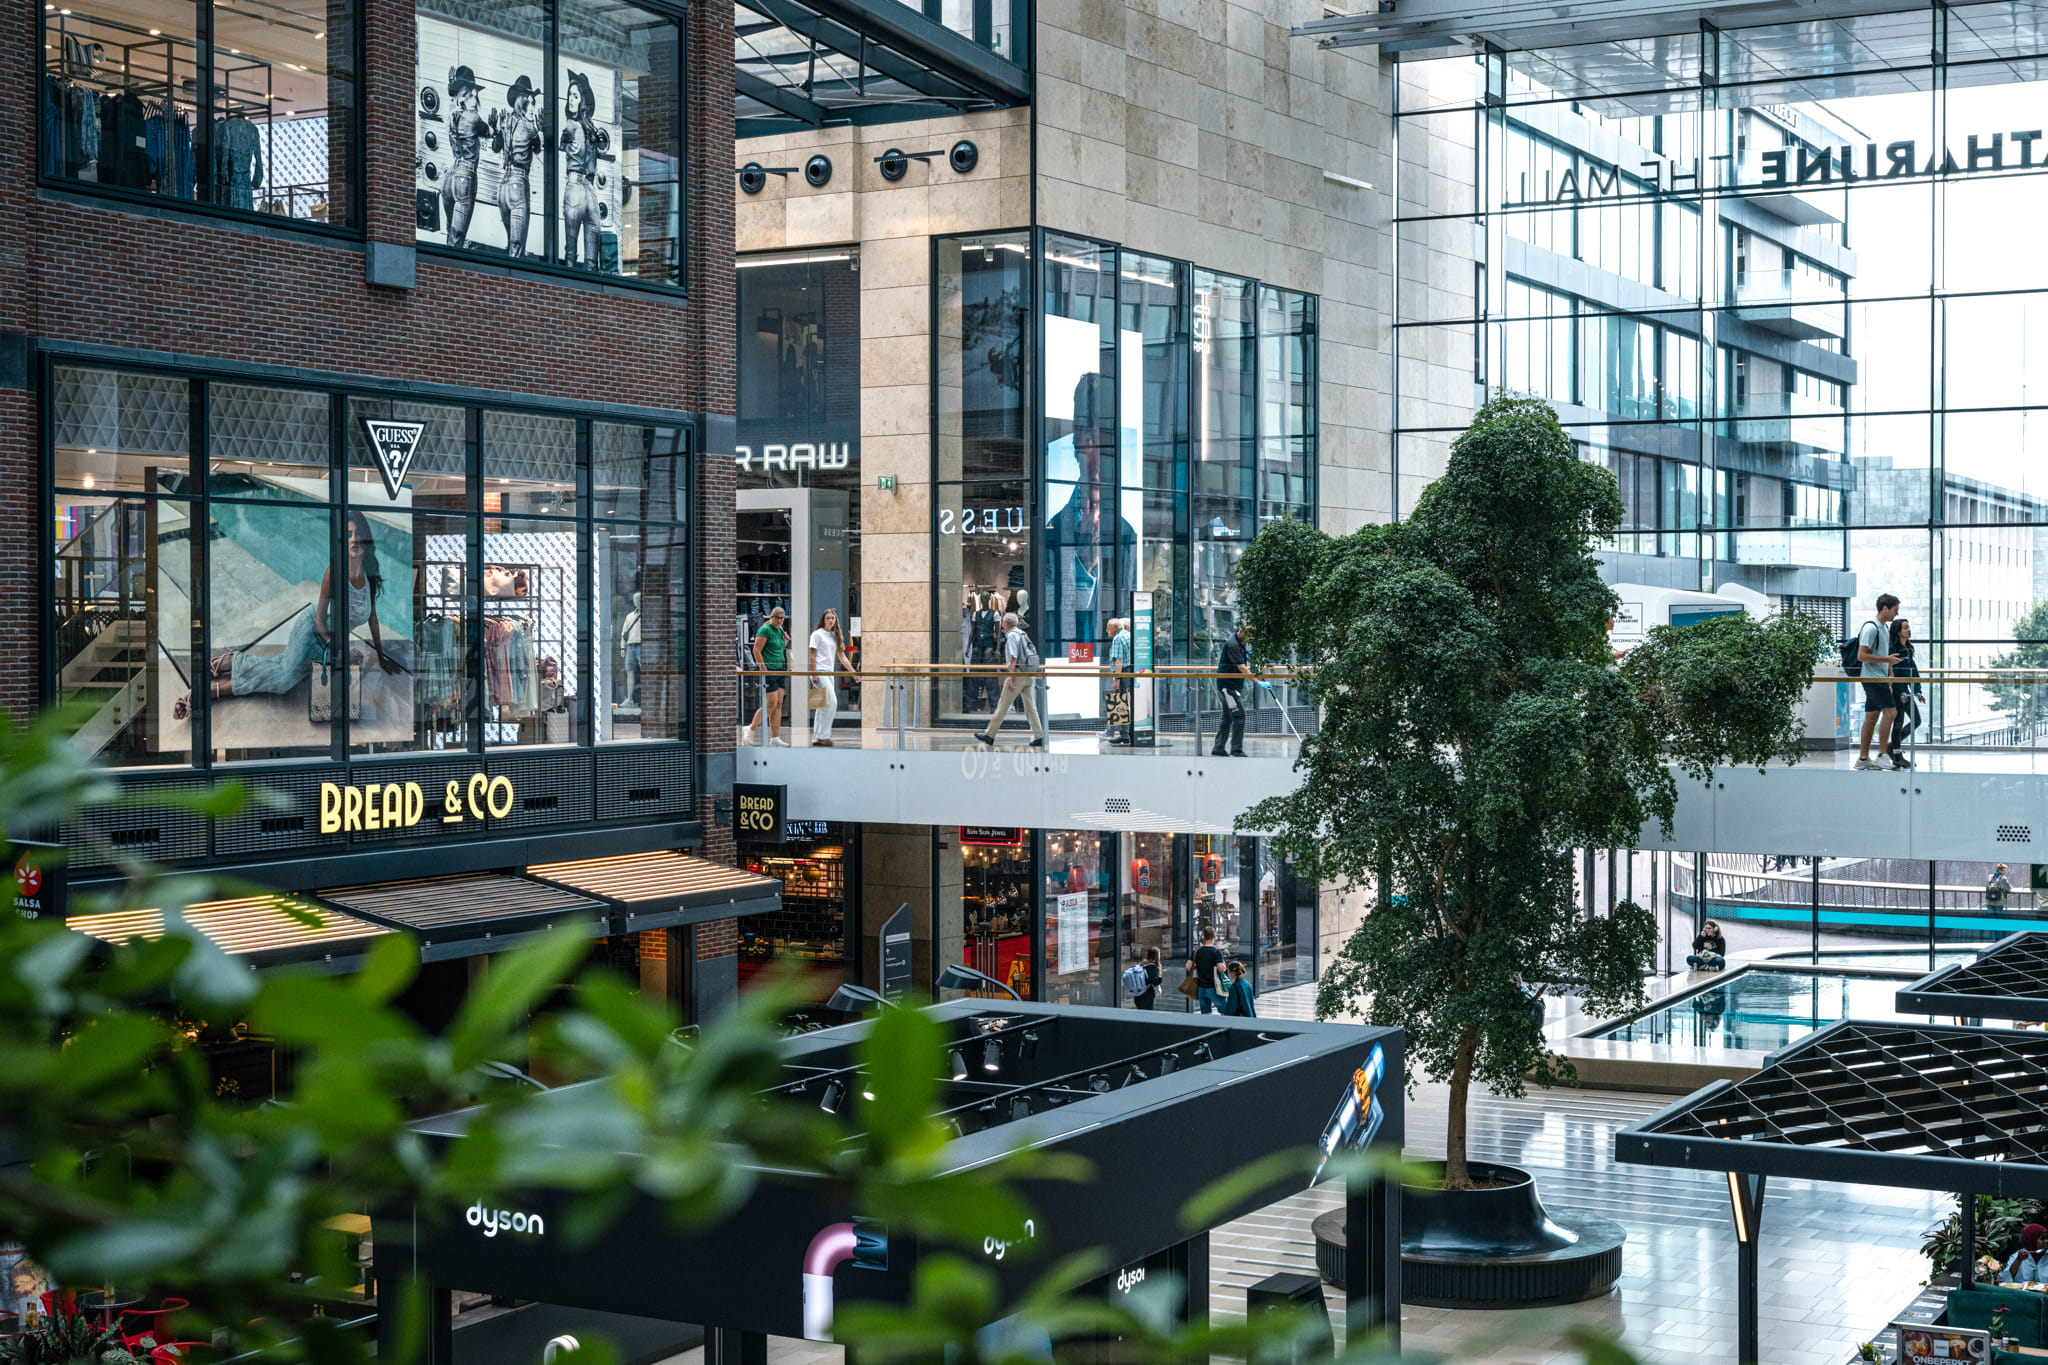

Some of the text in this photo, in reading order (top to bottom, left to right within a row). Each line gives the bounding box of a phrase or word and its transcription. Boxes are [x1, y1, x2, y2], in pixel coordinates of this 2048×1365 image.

[376, 427, 415, 444] GUESS
[763, 442, 849, 471] RAW
[1071, 648, 1088, 658] SALE
[320, 782, 424, 834] BREAD
[740, 795, 774, 811] BREAD
[13, 897, 41, 908] SALSA
[466, 1197, 544, 1238] dyson
